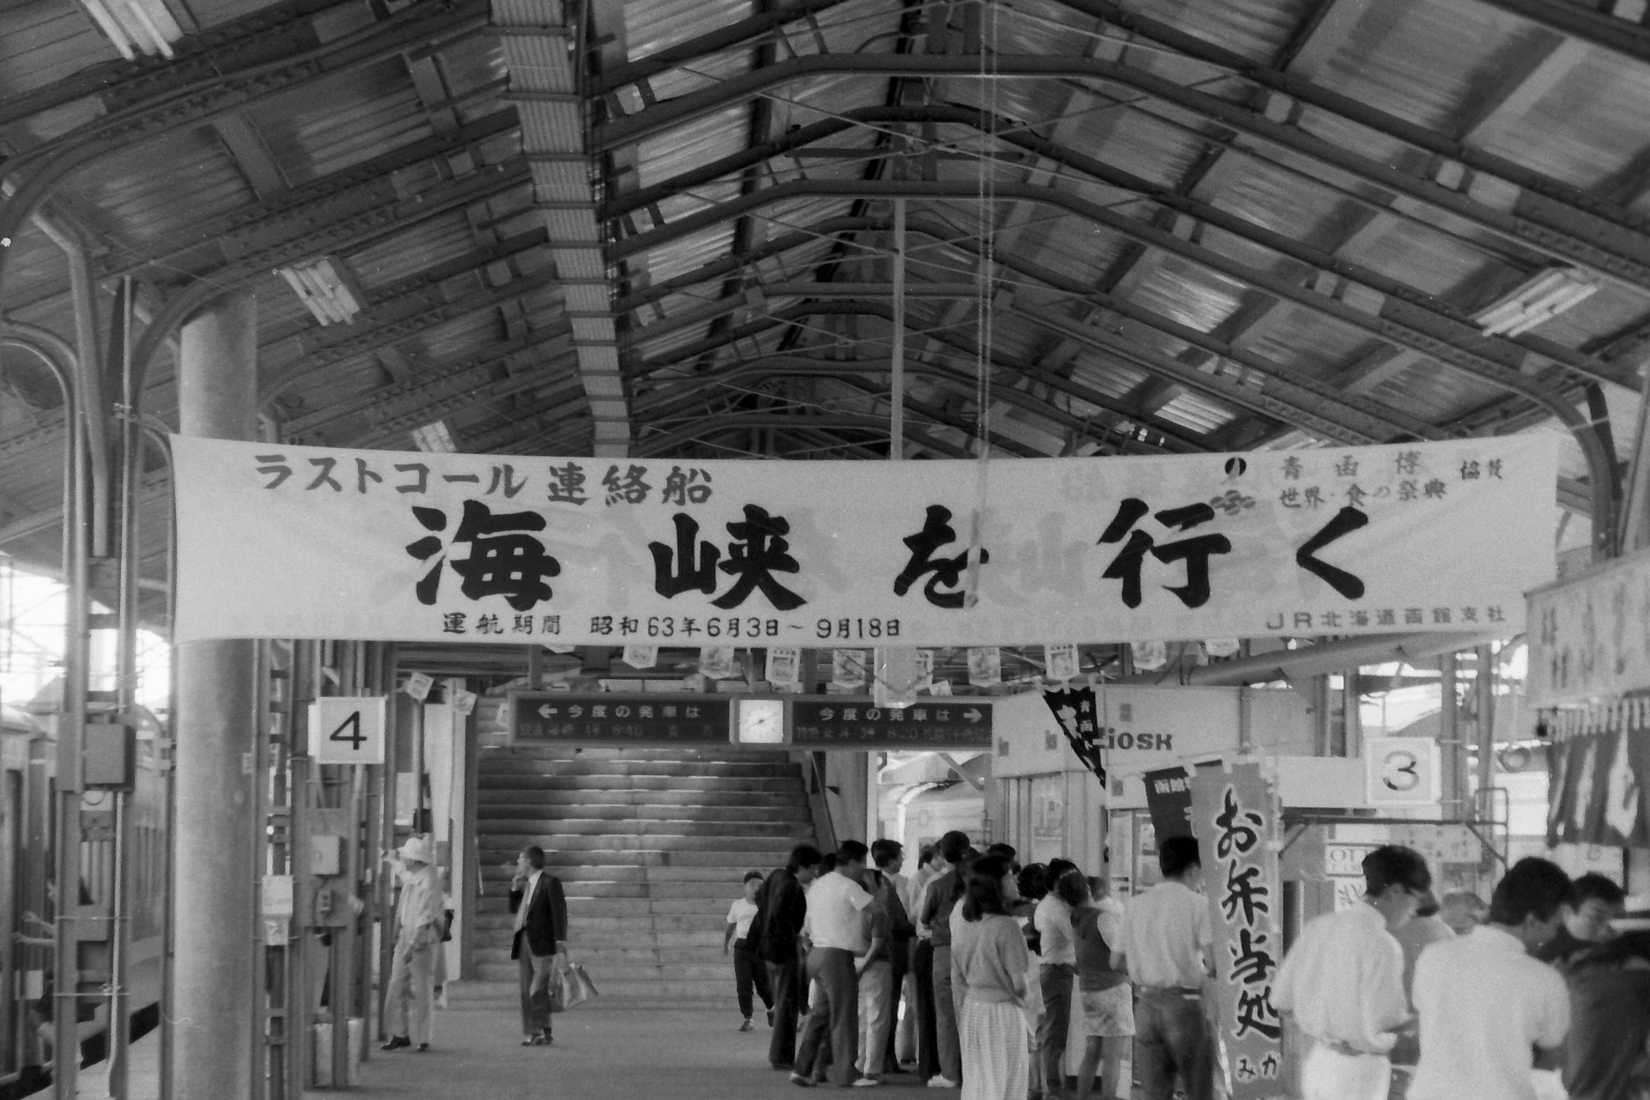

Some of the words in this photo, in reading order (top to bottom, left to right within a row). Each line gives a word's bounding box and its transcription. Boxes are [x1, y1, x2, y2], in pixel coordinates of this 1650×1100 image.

[254, 453, 714, 507] ラストコール連絡船
[404, 499, 1369, 612] 海峡を行く
[442, 612, 562, 636] 運航期間
[329, 710, 367, 751] 4
[567, 703, 702, 719] 今度の発車は
[819, 706, 951, 722] 今度の発車は
[1383, 751, 1420, 791] 3
